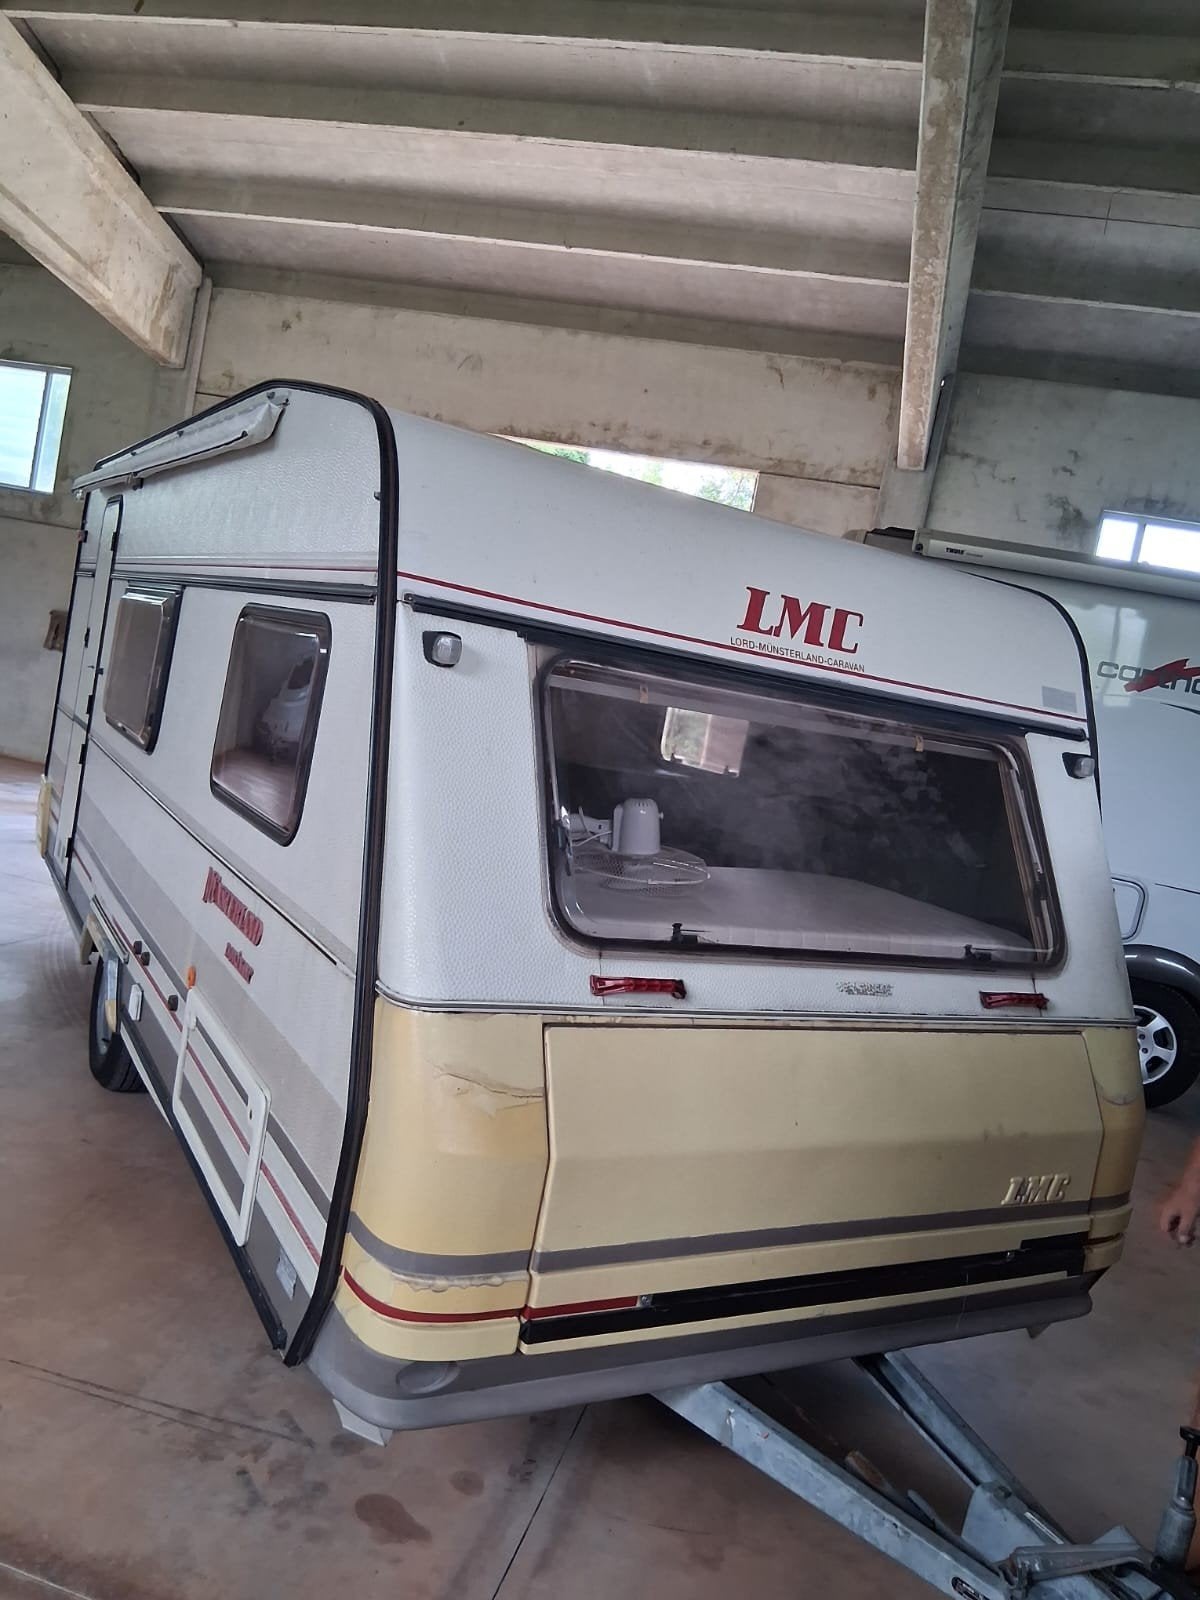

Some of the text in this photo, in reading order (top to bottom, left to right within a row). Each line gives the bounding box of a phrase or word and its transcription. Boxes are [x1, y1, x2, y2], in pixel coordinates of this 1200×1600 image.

[736, 586, 864, 654] LMC
[729, 636, 865, 673] LORD-MÜNSTERLAND-CARAVAN
[1001, 1173, 1071, 1206] LMC
